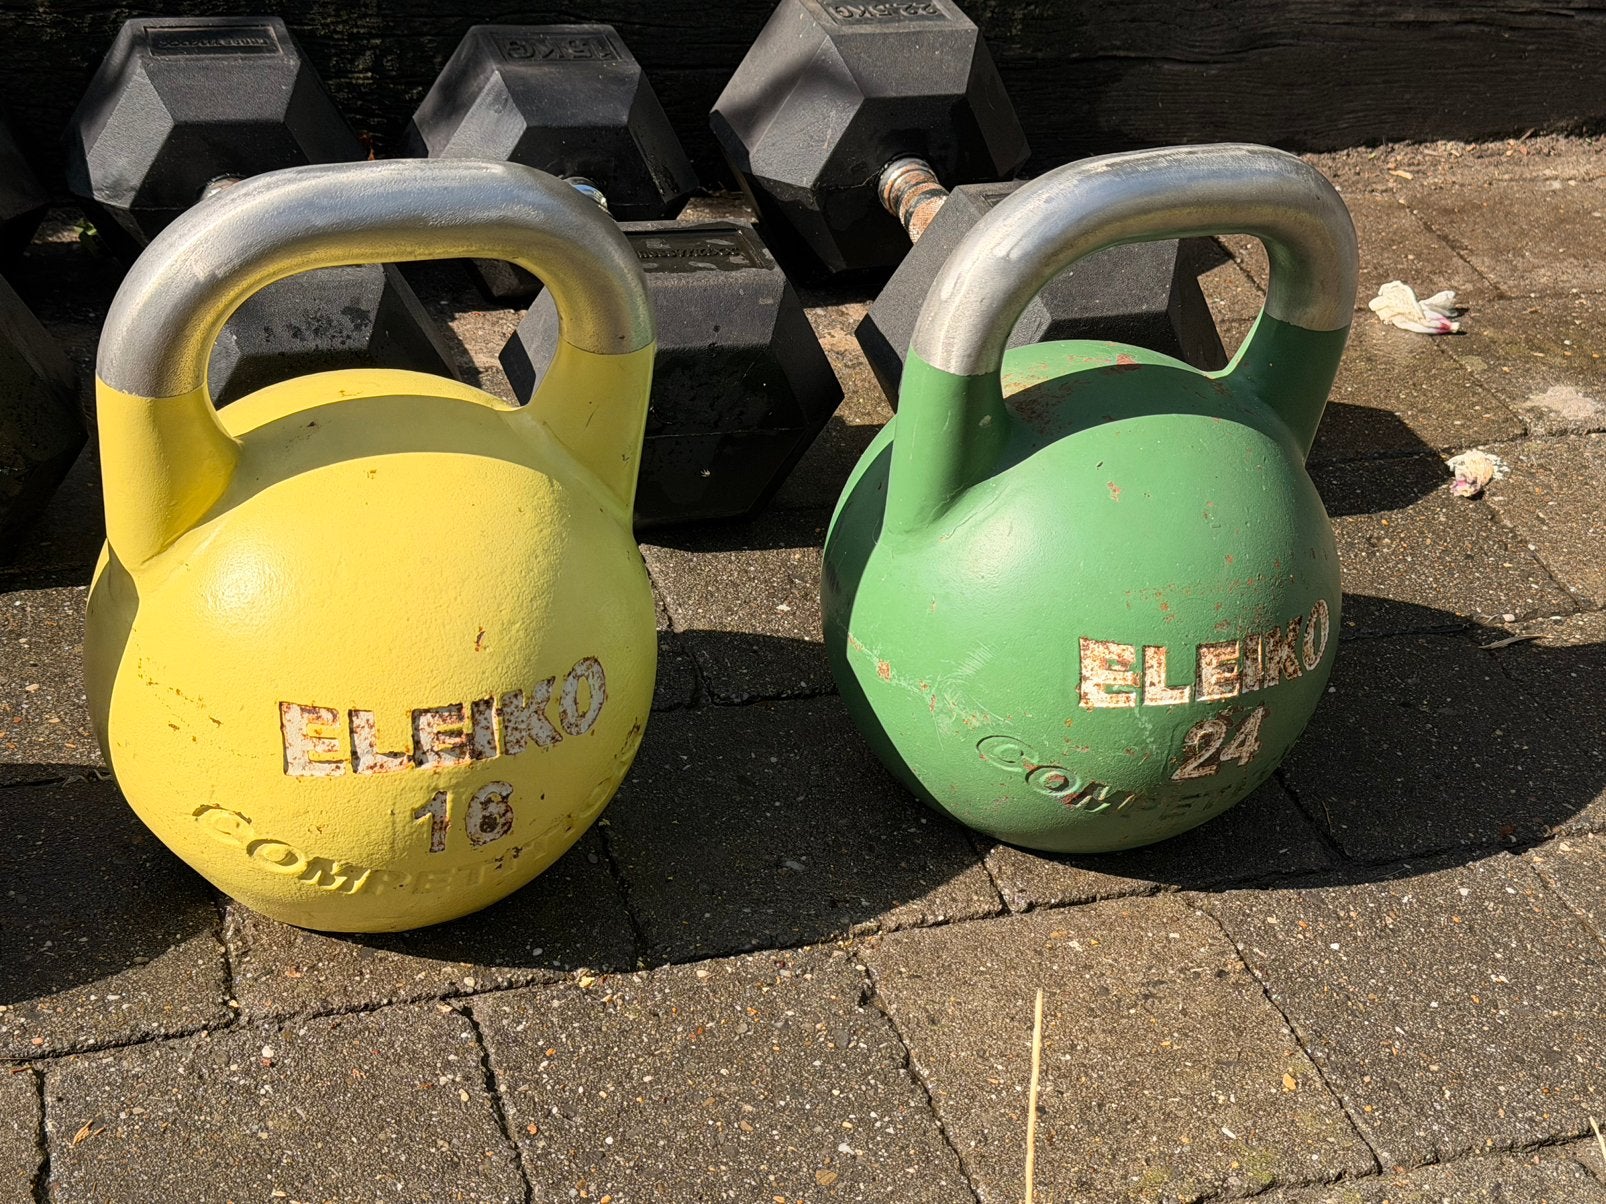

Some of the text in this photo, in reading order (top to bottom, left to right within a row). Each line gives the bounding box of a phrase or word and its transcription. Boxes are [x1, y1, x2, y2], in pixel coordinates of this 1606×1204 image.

[1078, 598, 1330, 708] ELEIKO
[279, 656, 607, 777] ELEIKO
[1170, 704, 1267, 780] 24
[413, 780, 514, 854] 16
